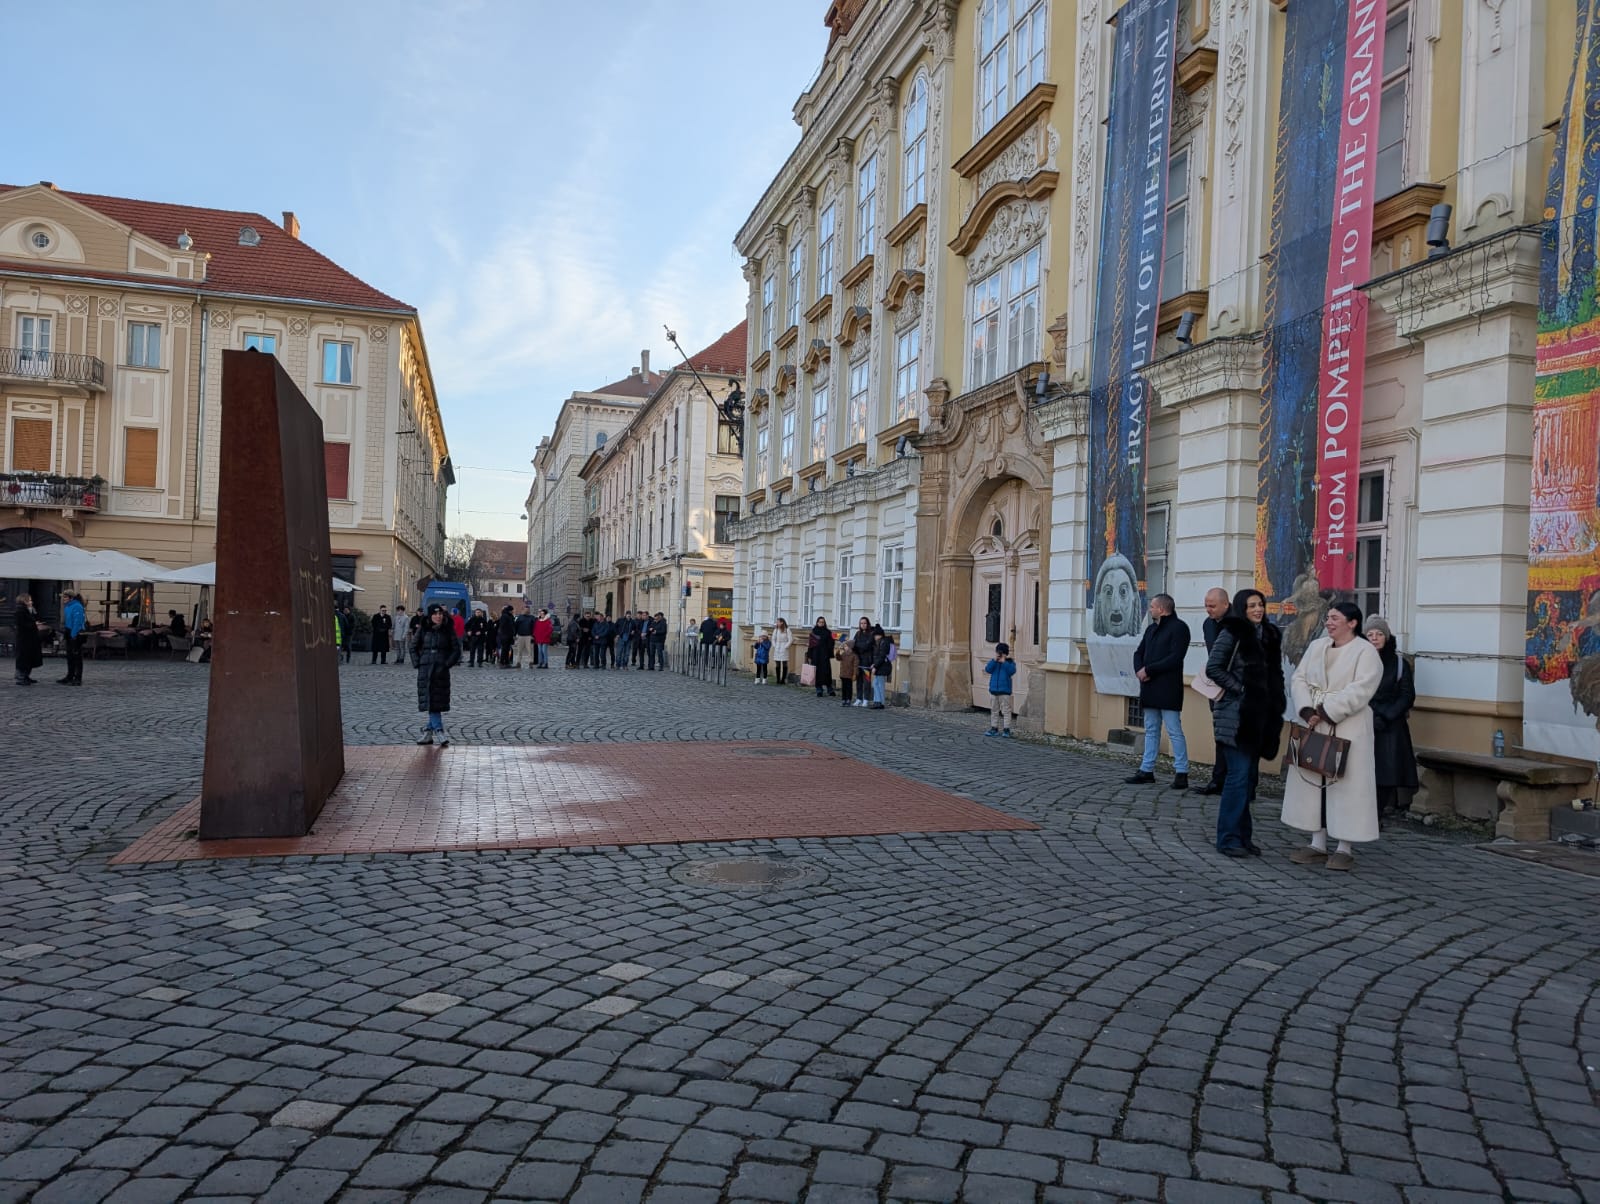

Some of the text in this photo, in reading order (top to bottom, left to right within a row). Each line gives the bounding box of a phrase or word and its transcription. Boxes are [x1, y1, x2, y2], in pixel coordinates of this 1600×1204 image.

[1128, 18, 1170, 465] FRAGILITY OF THE ETERNAL
[1324, 0, 1377, 555] FROM POMPEII TO THE GRAN
